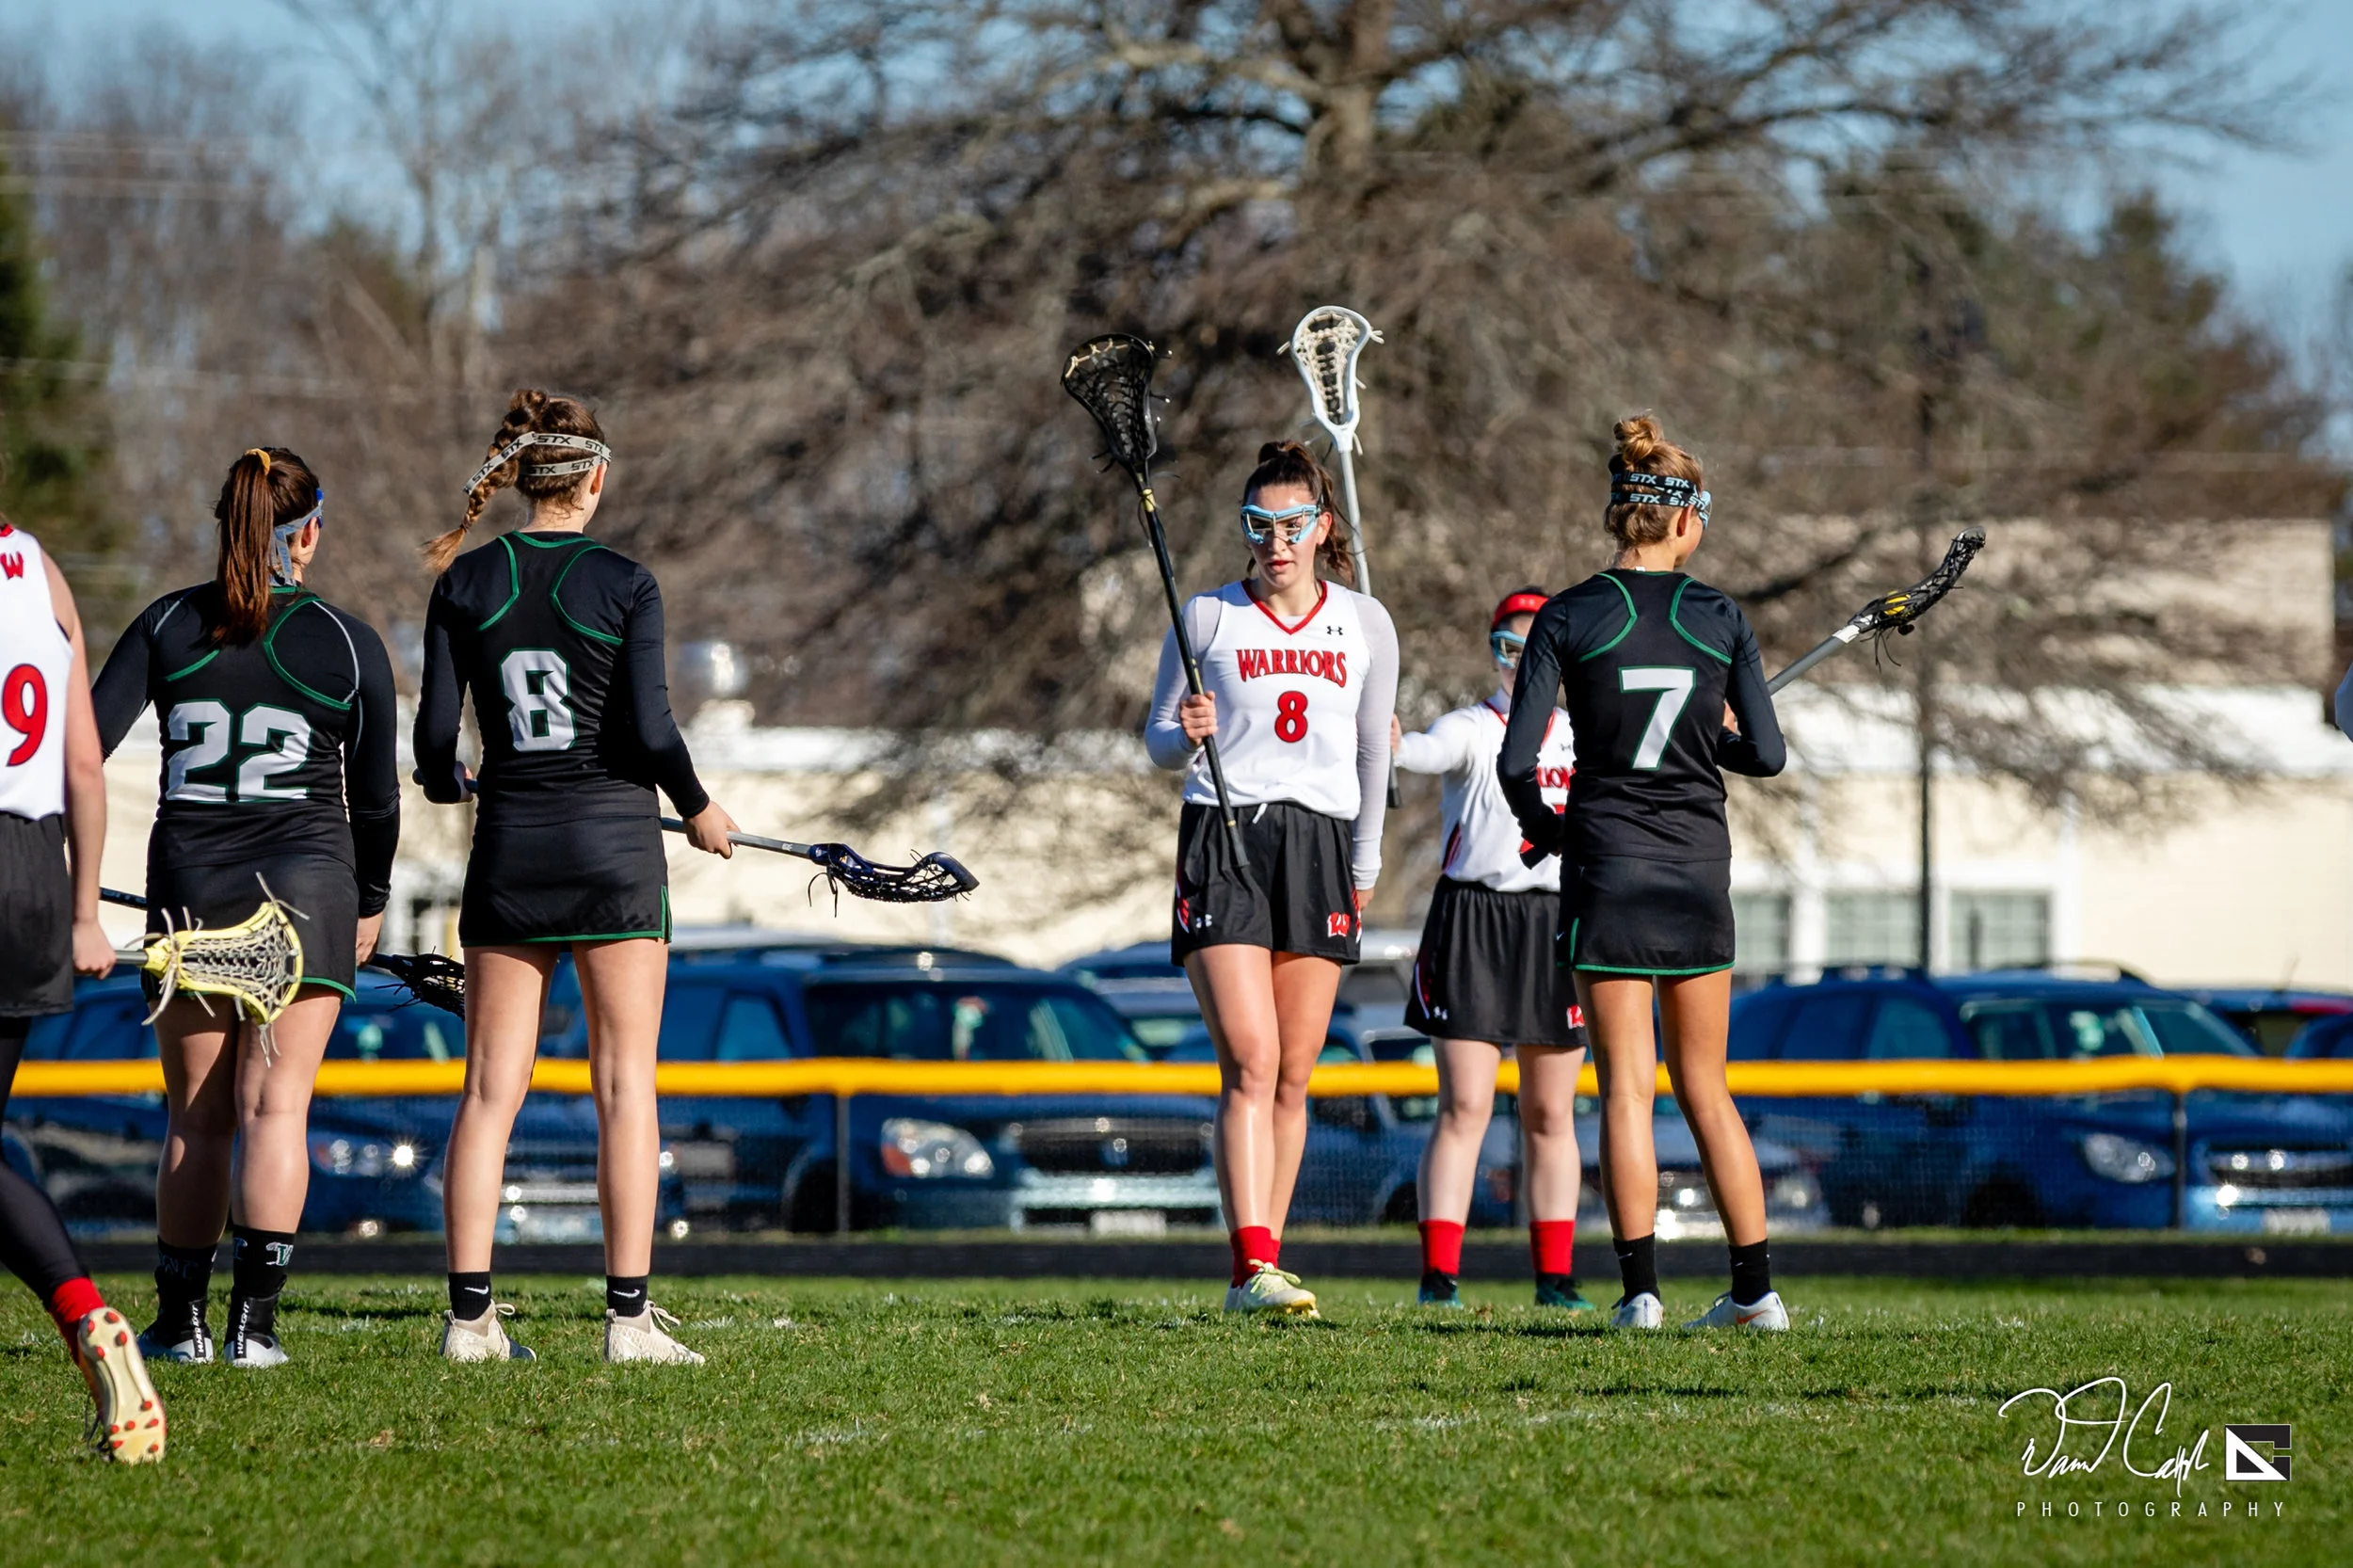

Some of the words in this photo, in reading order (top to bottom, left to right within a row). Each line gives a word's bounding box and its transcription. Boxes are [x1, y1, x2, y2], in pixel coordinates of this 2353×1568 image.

[537, 435, 571, 445] STX
[472, 462, 494, 482] STX
[571, 459, 594, 471] STX
[1630, 472, 1657, 485] STX
[1664, 476, 1690, 488] STX
[1629, 493, 1660, 504] STX
[0, 553, 28, 580] W
[1237, 649, 1348, 688] WARRIORS
[499, 648, 577, 753] 8
[2, 663, 48, 767] 9
[1274, 691, 1308, 743] 8
[1618, 664, 1696, 771] 7
[165, 699, 312, 803] 22
[1327, 912, 1351, 937] W
